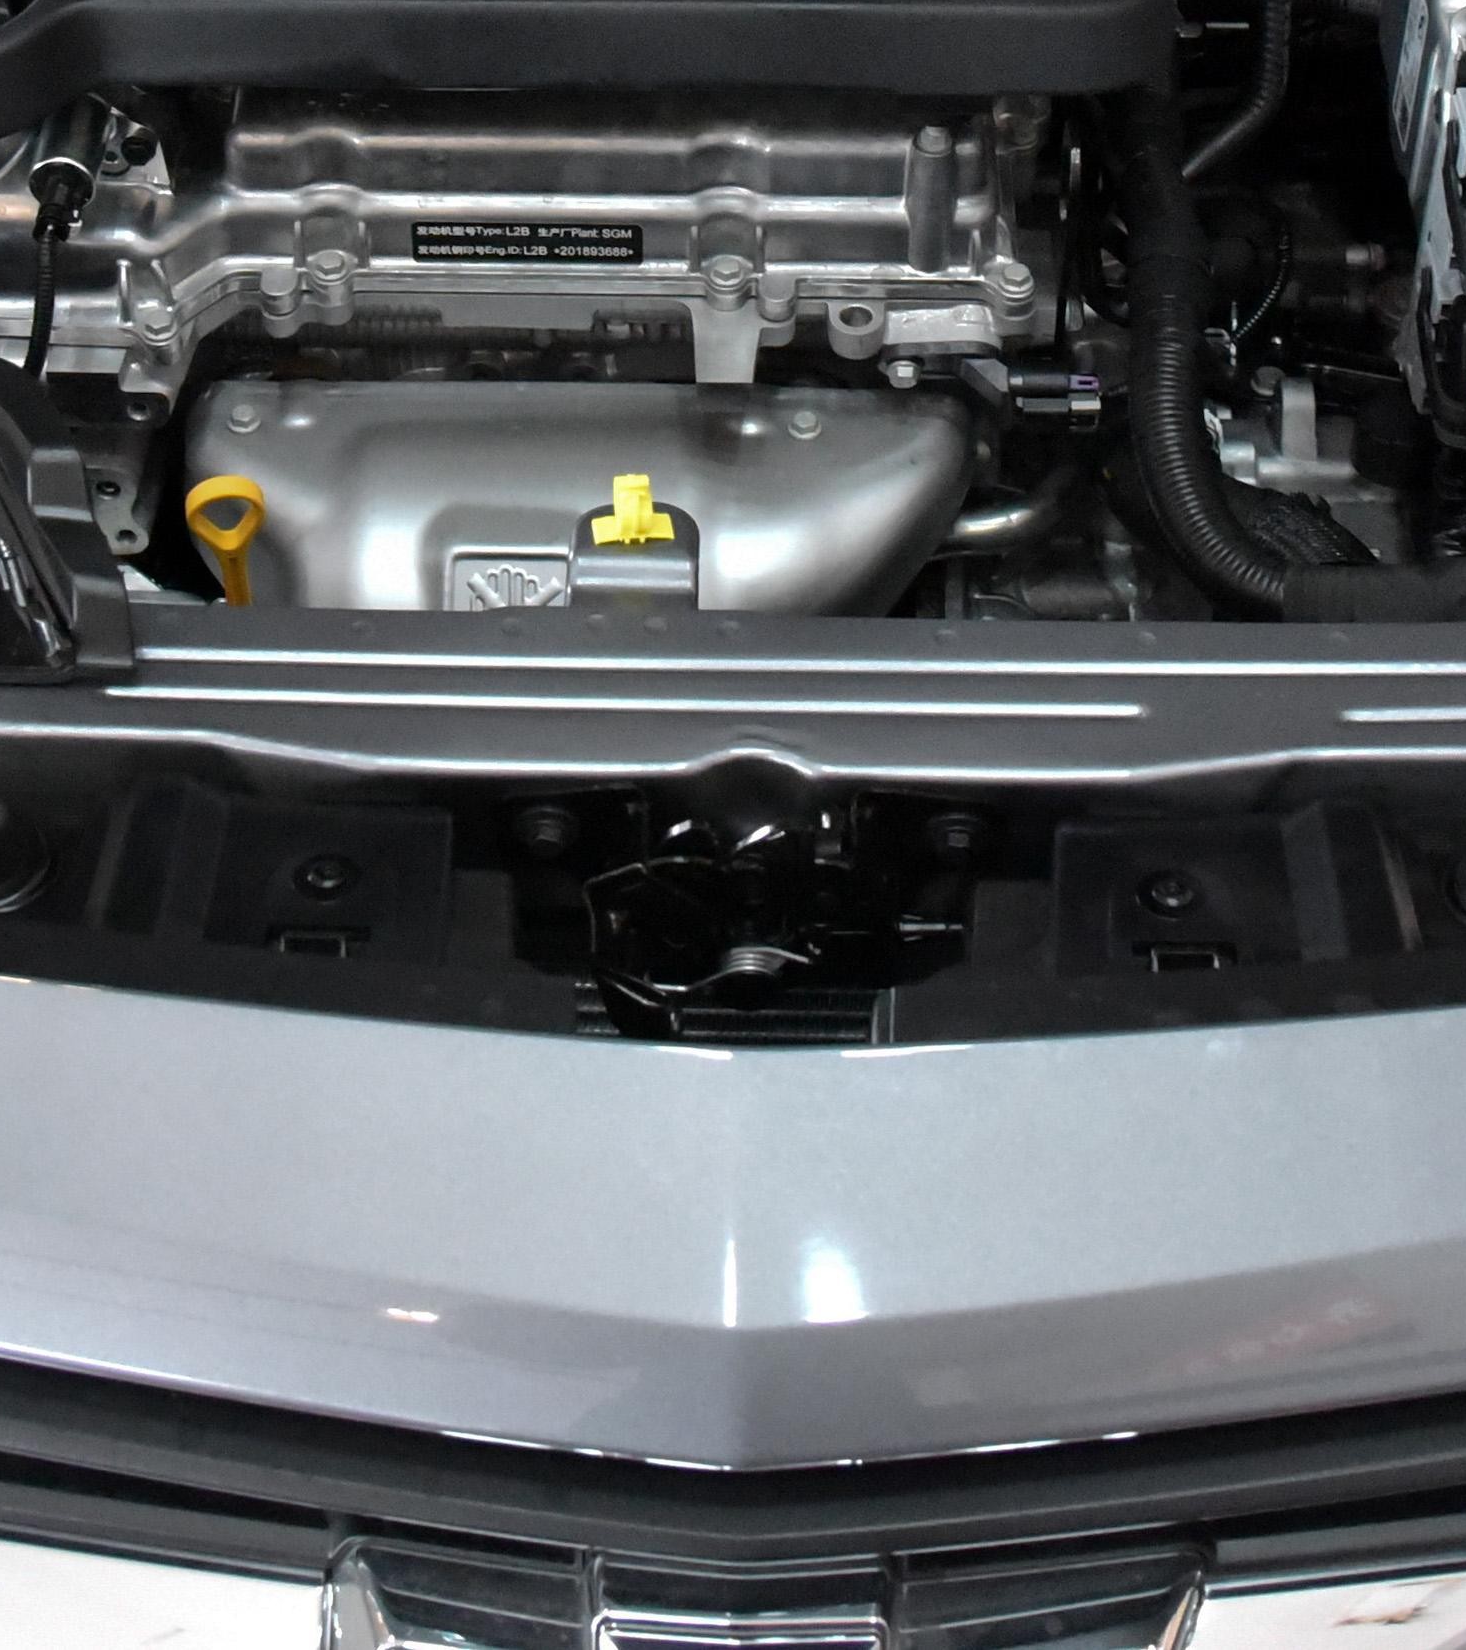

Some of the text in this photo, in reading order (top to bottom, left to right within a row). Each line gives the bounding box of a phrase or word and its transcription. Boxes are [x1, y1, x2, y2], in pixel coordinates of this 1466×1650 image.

[505, 226, 531, 237] L2B
[601, 229, 632, 239] SGM
[523, 246, 548, 256] L2B
